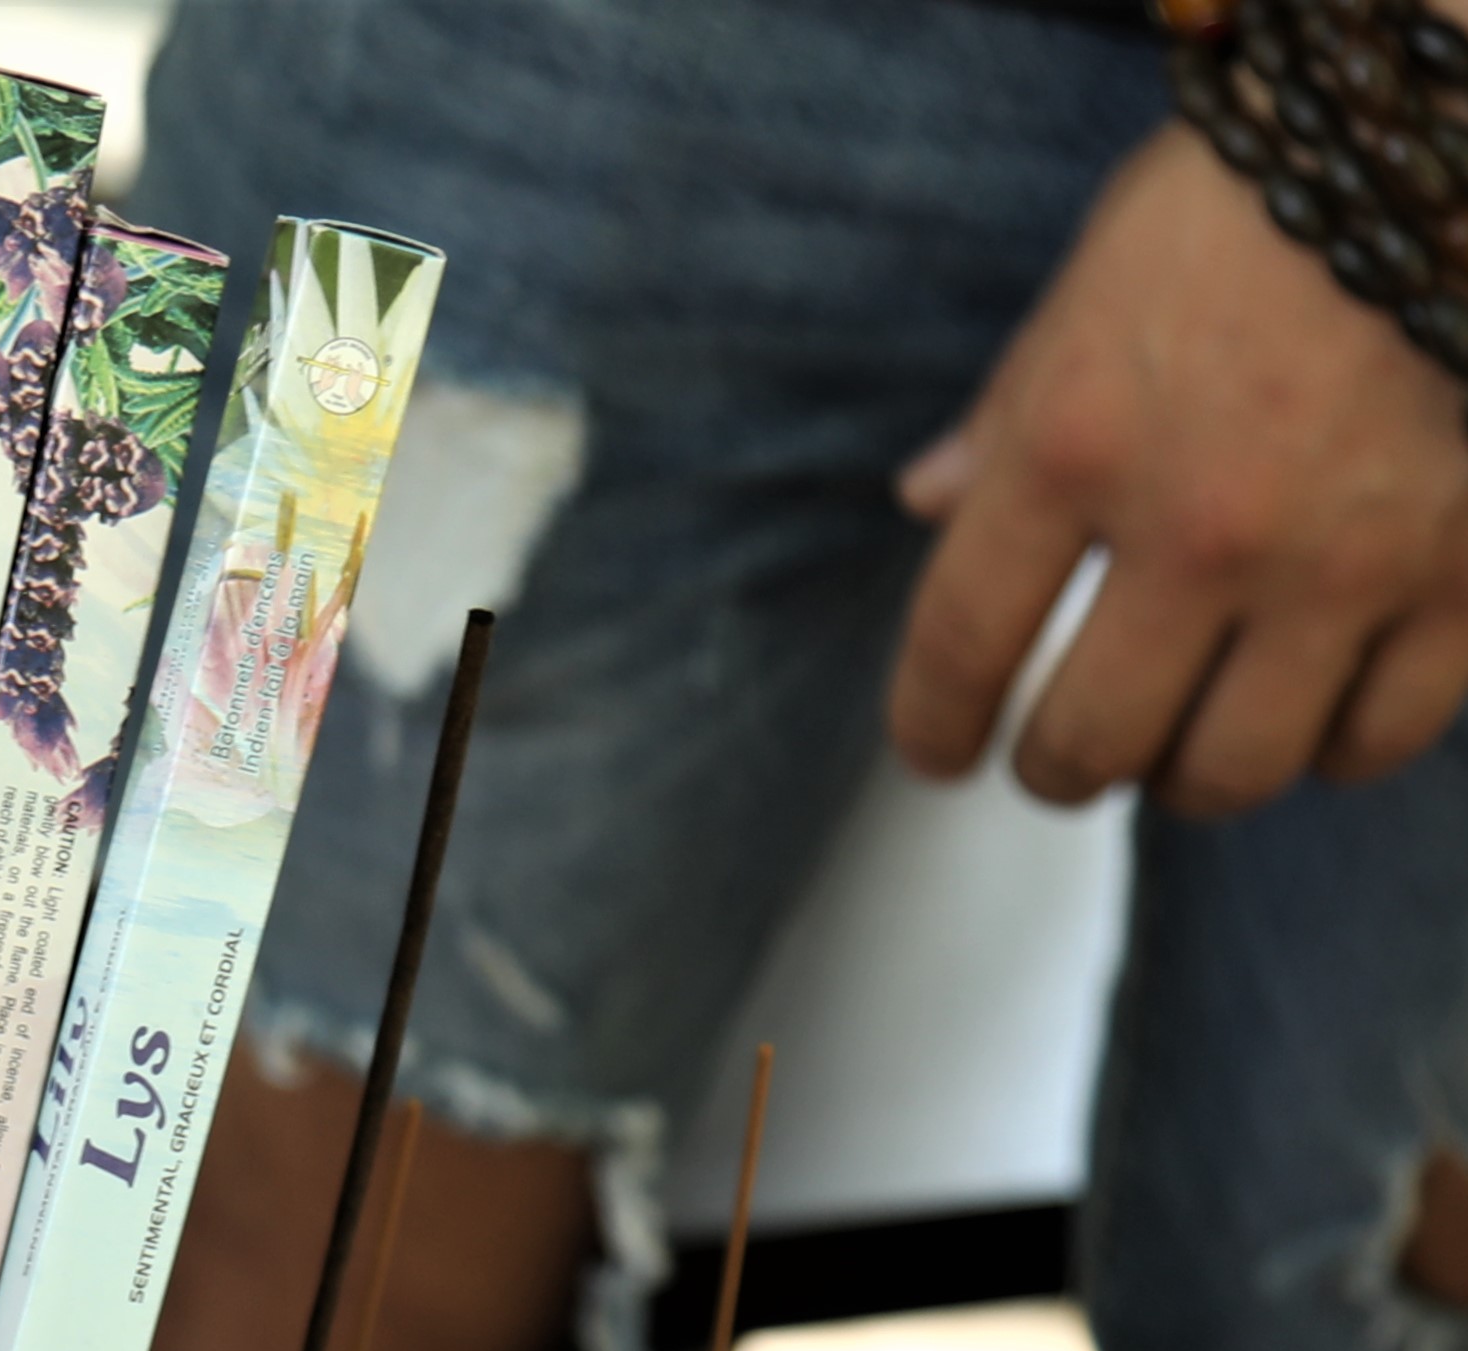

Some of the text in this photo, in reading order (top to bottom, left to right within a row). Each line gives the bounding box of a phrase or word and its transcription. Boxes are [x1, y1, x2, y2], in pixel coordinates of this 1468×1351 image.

[283, 549, 315, 609] main
[209, 549, 285, 761] Bâtonnets d'encens
[274, 611, 300, 638] la
[256, 662, 286, 703] fait
[238, 703, 275, 776] Indien
[76, 1018, 184, 1192] Lys
[128, 923, 243, 1305] SENTIMENTAL, GRACIEUX ET CORDIAL
